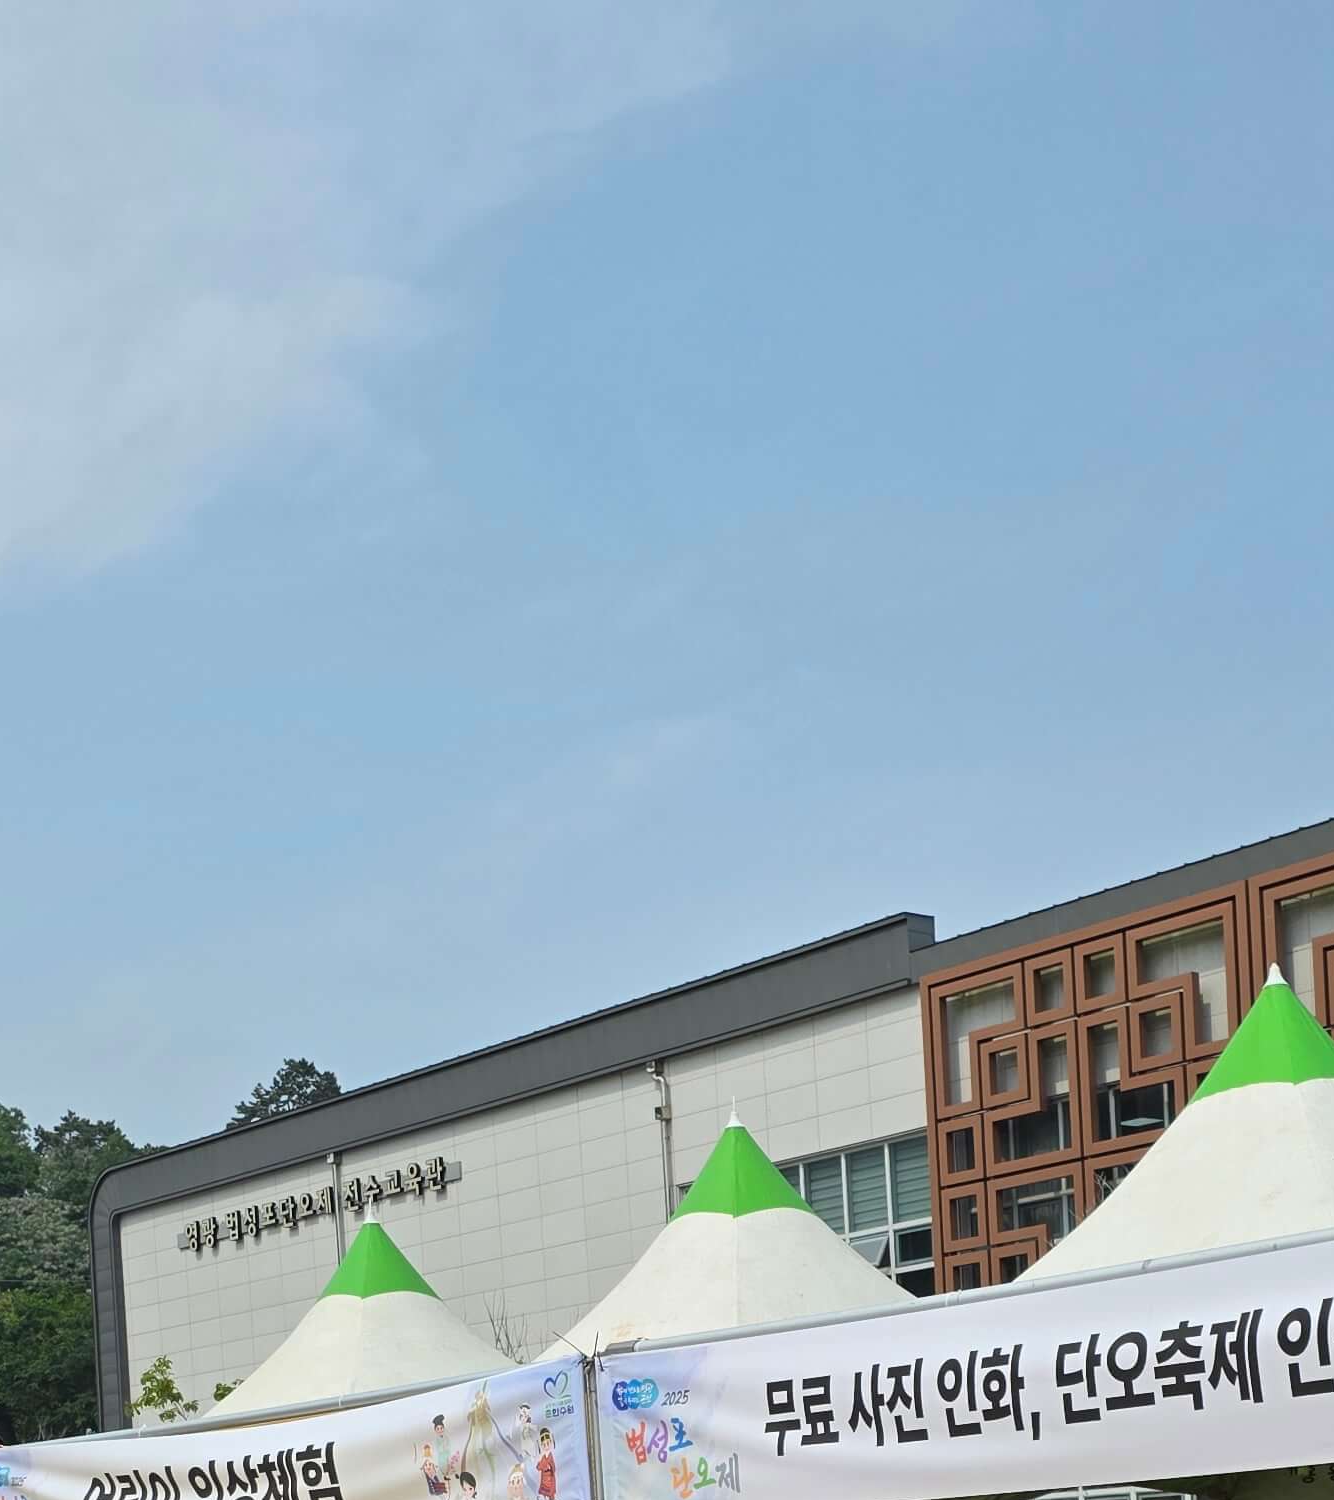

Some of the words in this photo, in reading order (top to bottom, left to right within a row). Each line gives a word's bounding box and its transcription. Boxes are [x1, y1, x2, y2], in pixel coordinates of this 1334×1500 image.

[185, 1216, 218, 1250] 영광
[226, 1186, 334, 1240] 법성포단오제
[344, 1157, 444, 1212] 전수교육관
[661, 1389, 690, 1407] 2025
[764, 1374, 840, 1457] 무료
[849, 1356, 929, 1447] 사진
[936, 1343, 1041, 1441] 인화,
[1054, 1308, 1264, 1424] 단오축제
[670, 1452, 741, 1499] 단오제
